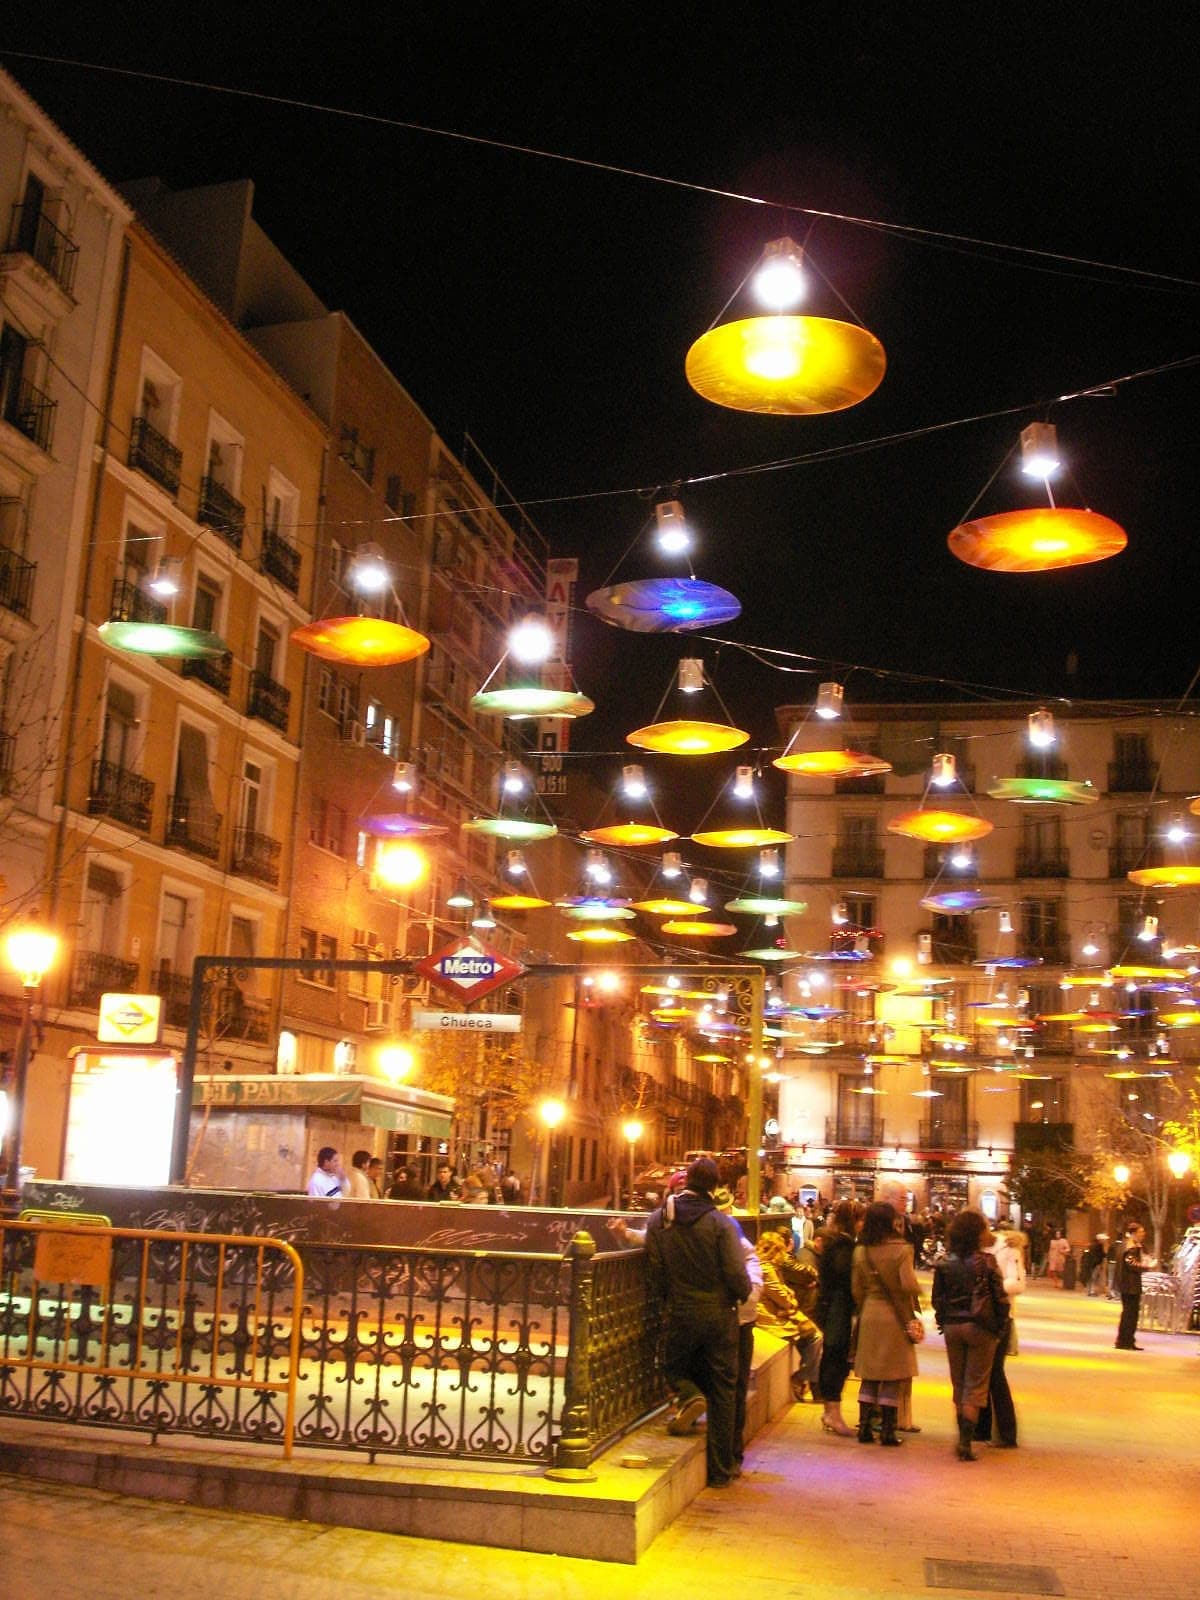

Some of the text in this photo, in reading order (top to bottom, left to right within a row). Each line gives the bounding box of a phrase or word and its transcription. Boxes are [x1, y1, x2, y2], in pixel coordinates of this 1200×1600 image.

[444, 959, 492, 974] Metro
[440, 1016, 493, 1028] Chueca
[201, 1082, 236, 1104] EL
